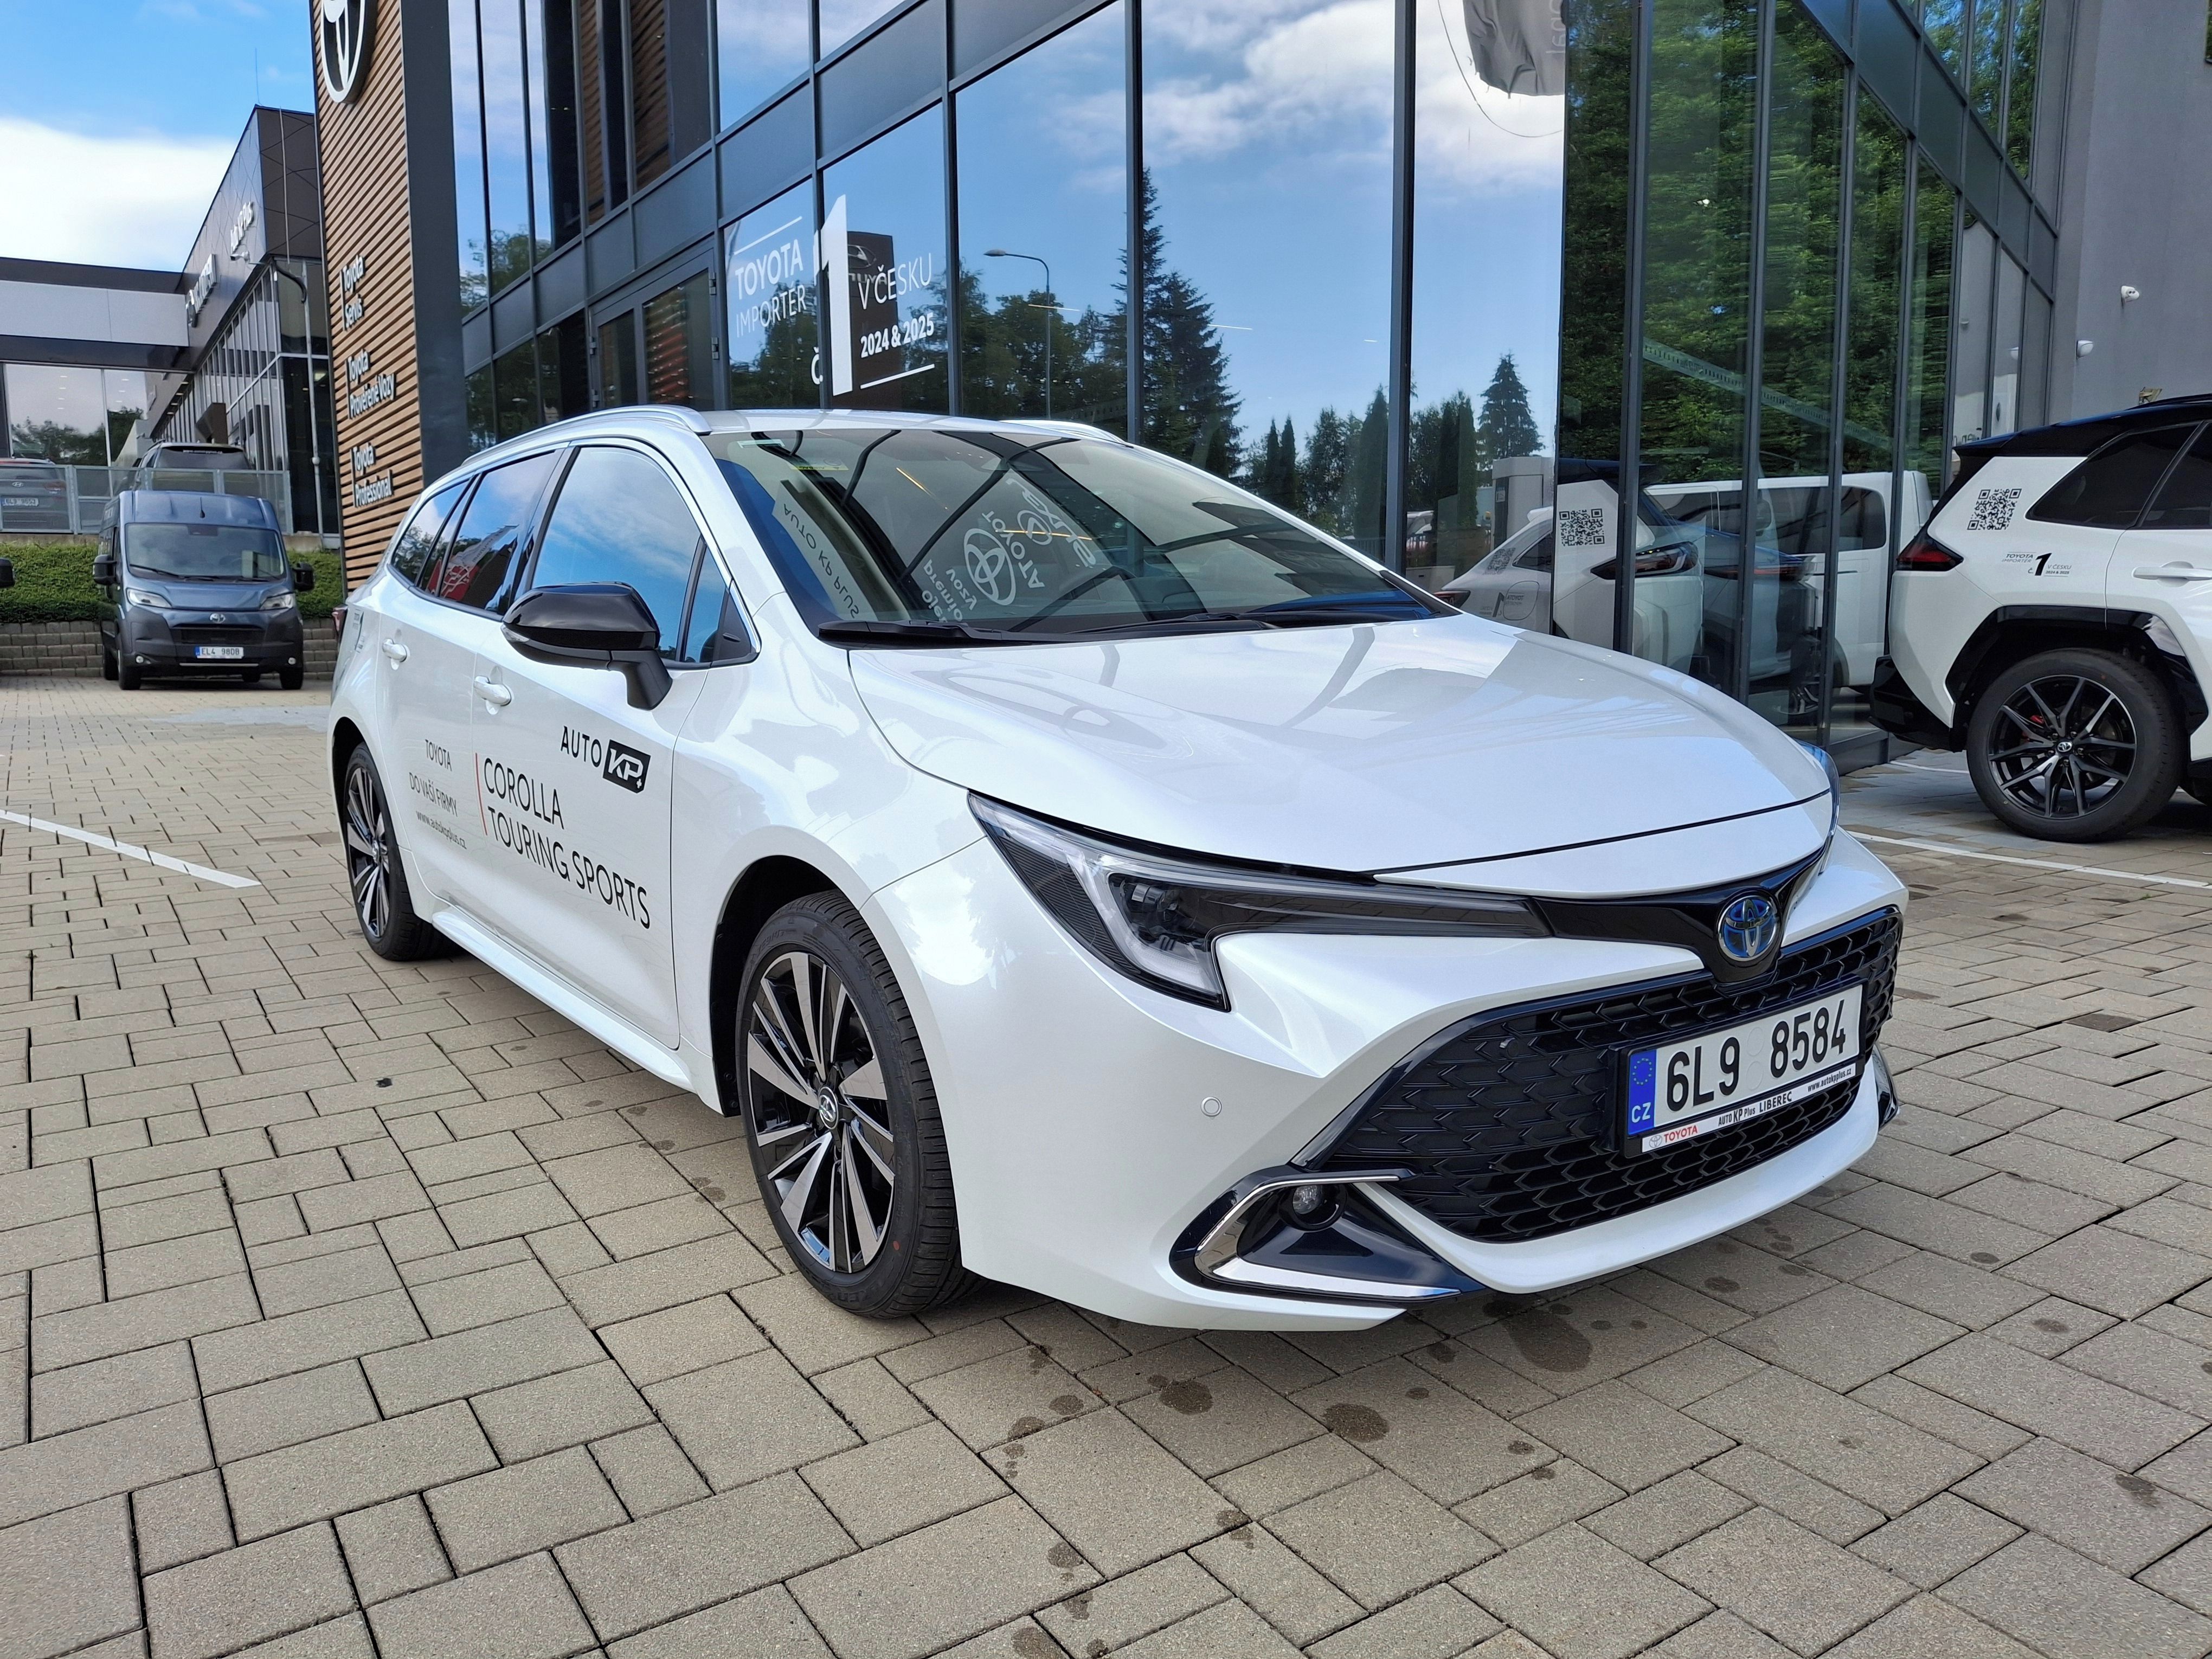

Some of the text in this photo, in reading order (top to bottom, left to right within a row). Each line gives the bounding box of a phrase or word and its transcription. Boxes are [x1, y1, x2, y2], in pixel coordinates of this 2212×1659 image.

[343, 255, 364, 293] Toyota
[735, 239, 803, 299] TOYOTA
[858, 253, 931, 310] V ČESKU
[345, 293, 363, 328] Servis
[736, 280, 807, 338] IMPORTÉR
[814, 194, 853, 396] 1
[860, 312, 934, 358] 2024 & 2025
[348, 349, 369, 385] Toyota
[378, 372, 394, 400] Vozy
[353, 442, 374, 476] Toyota
[355, 469, 392, 507] Professional
[2035, 552, 2052, 576] 1
[425, 739, 452, 772] TOYOTA
[561, 726, 601, 767] AUTO
[409, 772, 458, 817] DO VAŠÍ FIRMY
[484, 758, 564, 830] COROLLA
[487, 806, 650, 929] TOURING SPORTS
[1667, 999, 1846, 1112] 6L9 8584
[1631, 1102, 1651, 1123] CZ
[1664, 1068, 1852, 1143] TOYOTA AUTO KP Plus LIBEREC www.autokpplus.cz
